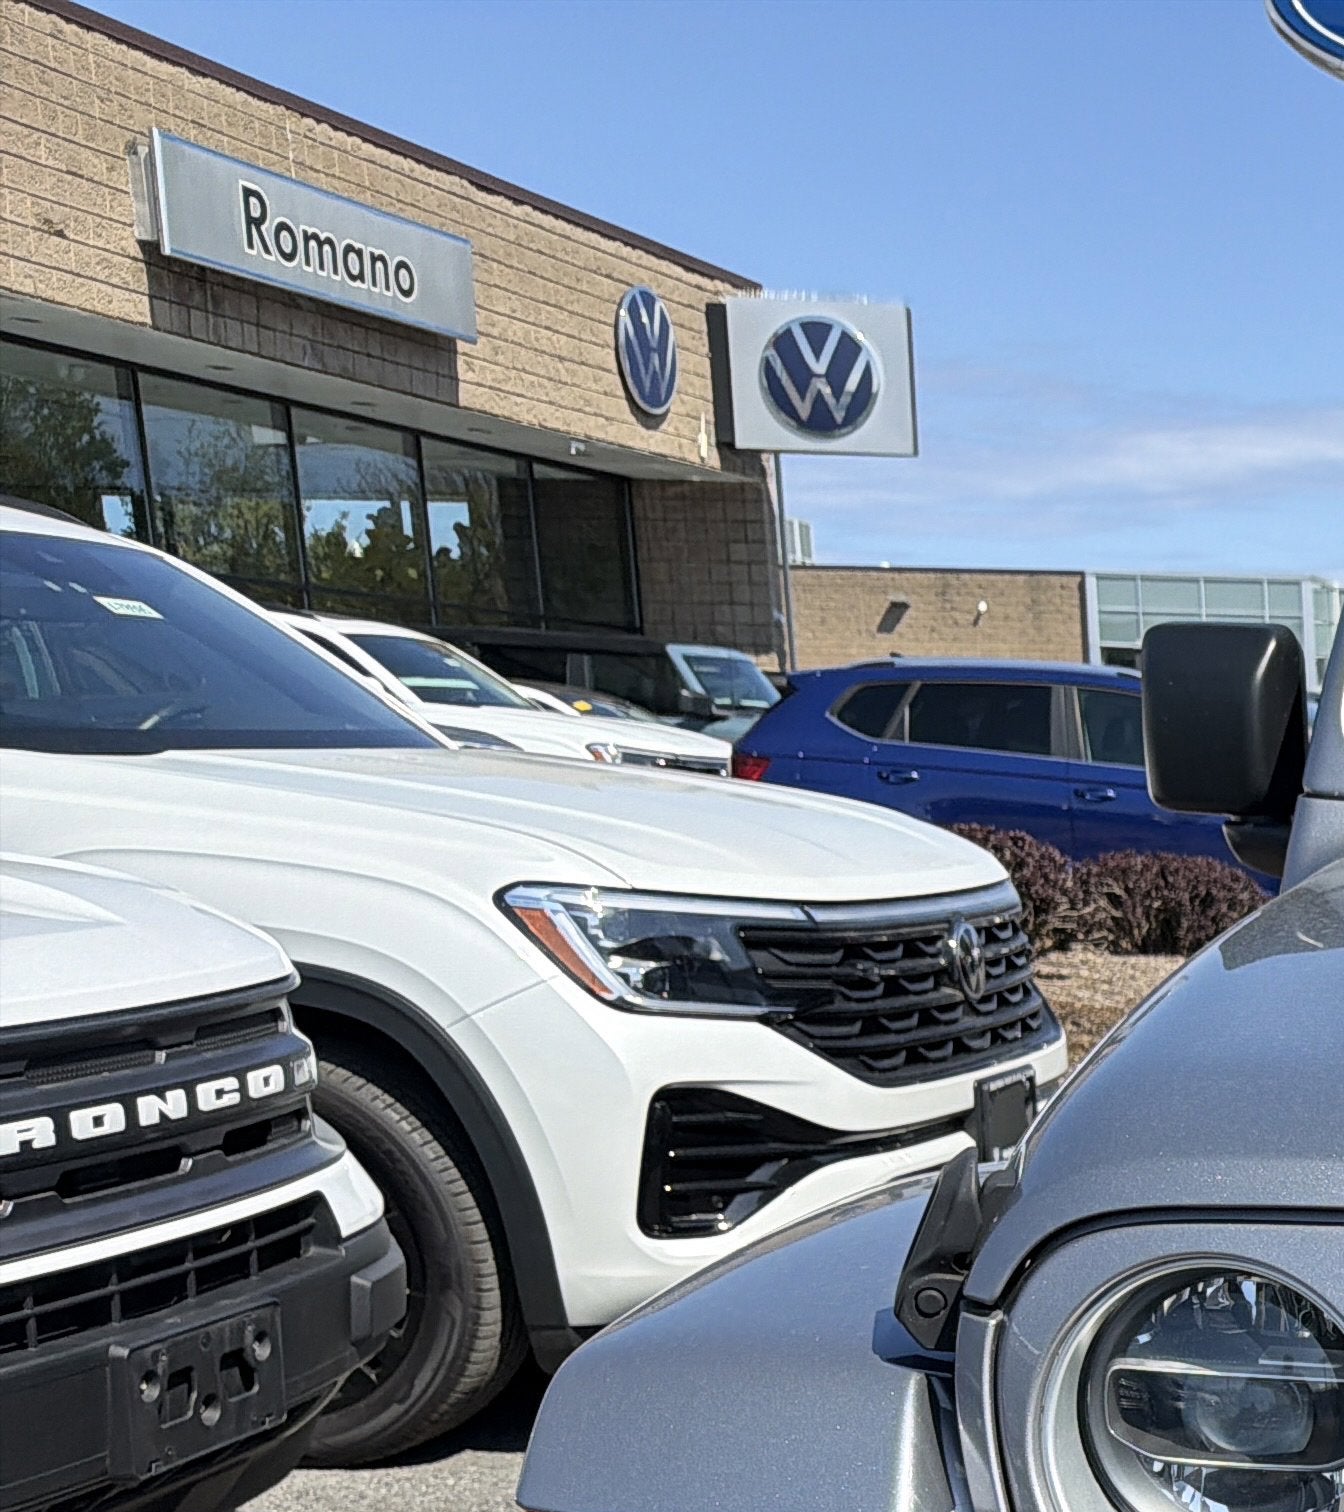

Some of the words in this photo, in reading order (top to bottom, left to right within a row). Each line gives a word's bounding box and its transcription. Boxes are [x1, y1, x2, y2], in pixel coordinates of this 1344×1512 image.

[240, 181, 417, 301] Romano
[621, 288, 675, 406] VW
[763, 319, 873, 428] VW
